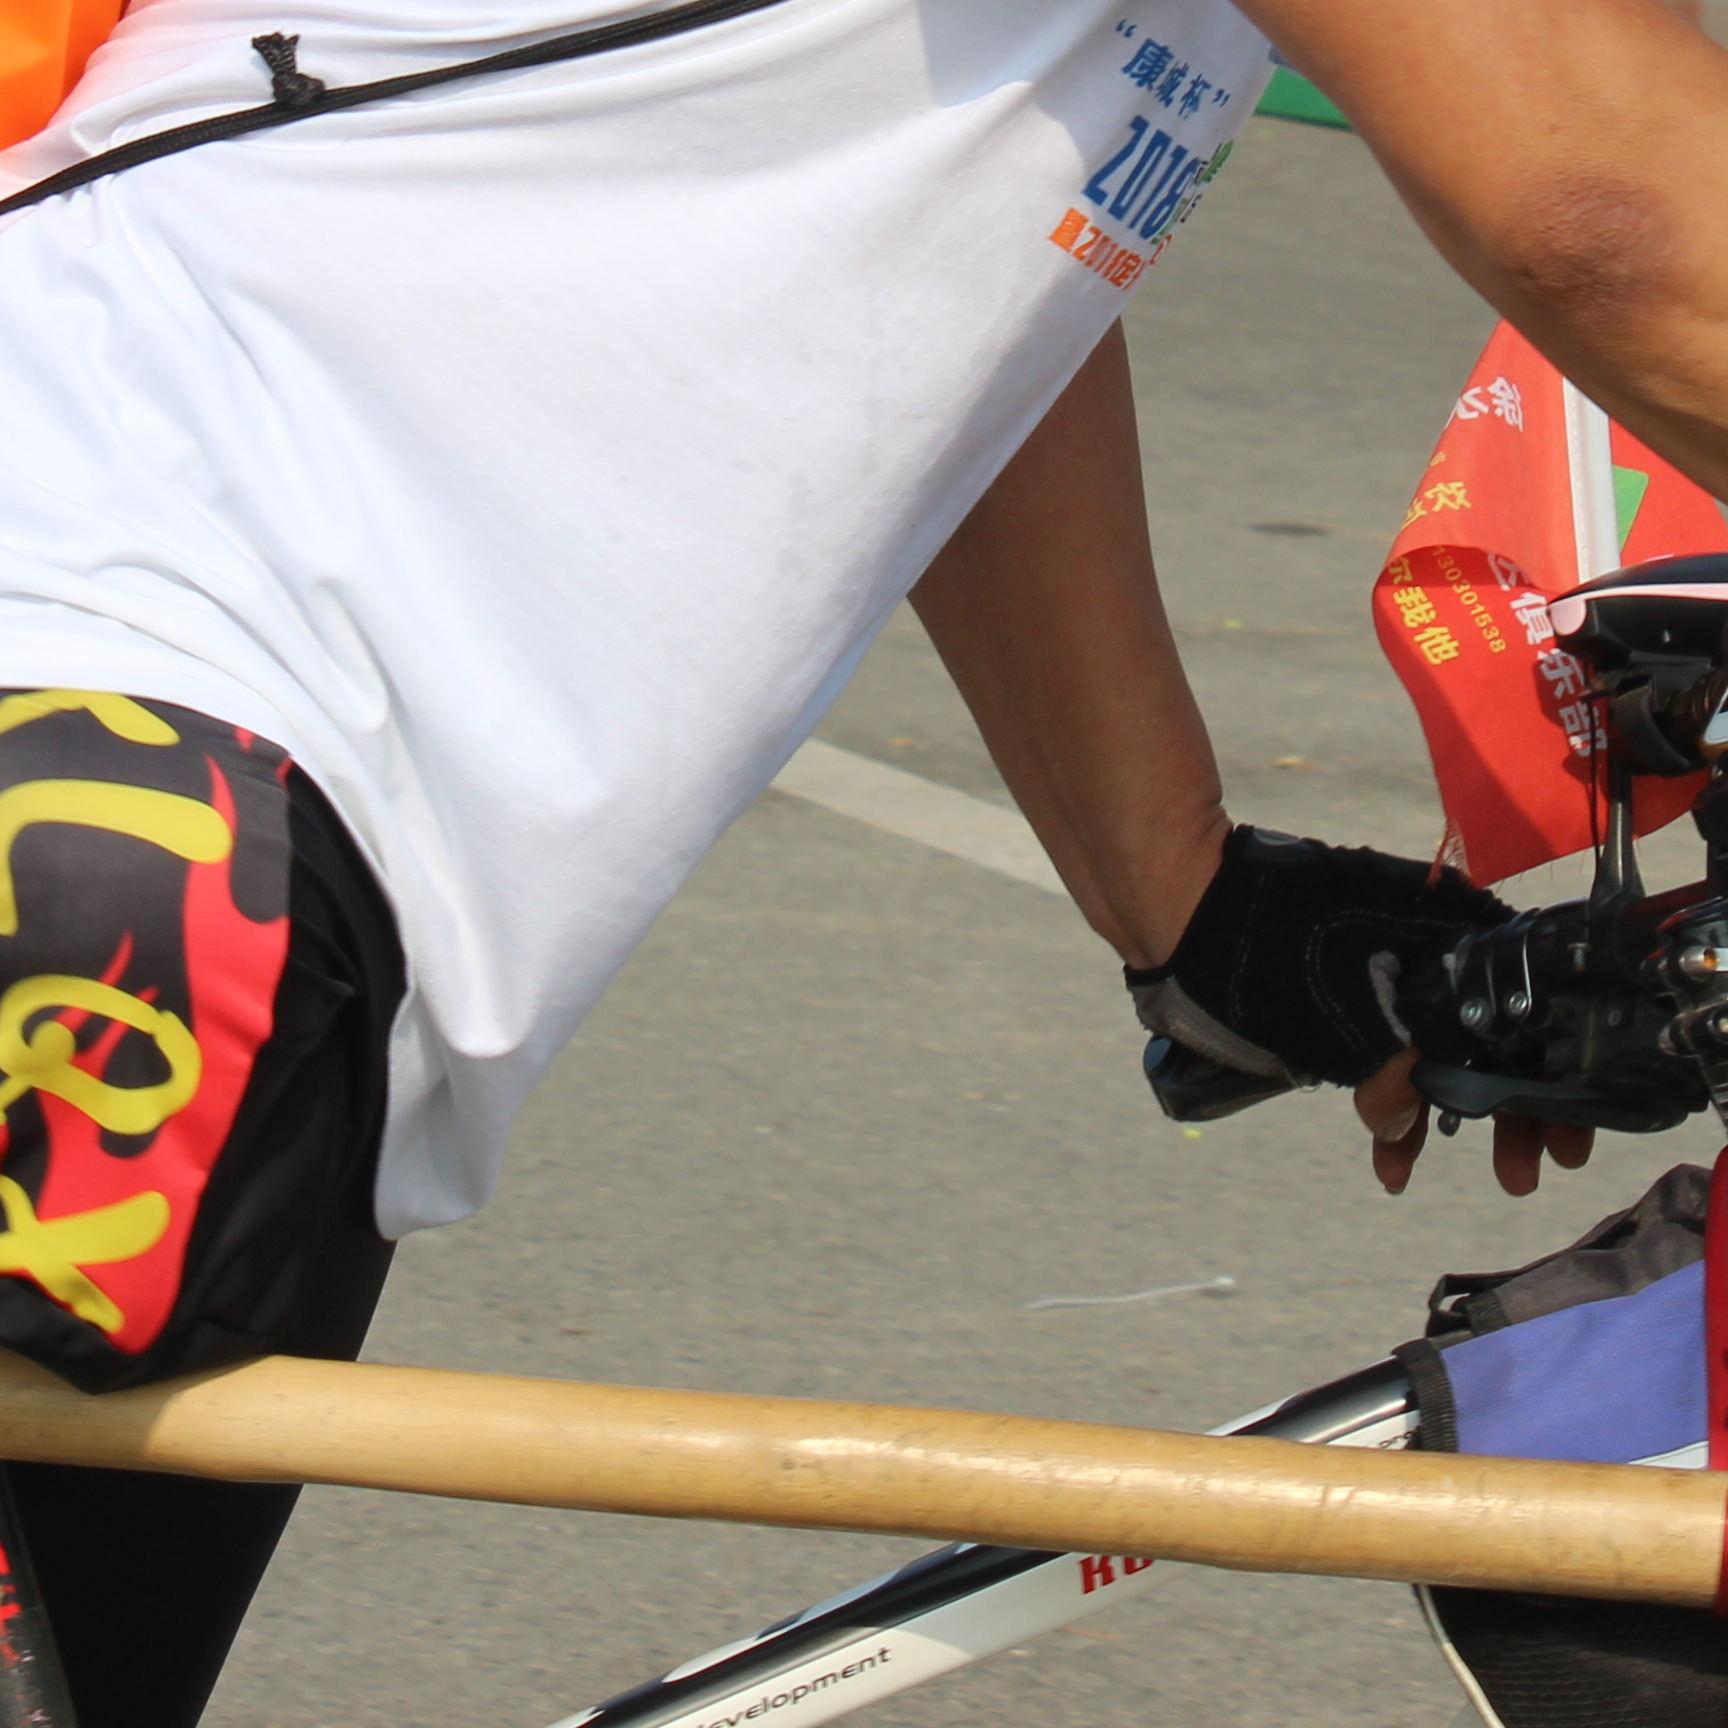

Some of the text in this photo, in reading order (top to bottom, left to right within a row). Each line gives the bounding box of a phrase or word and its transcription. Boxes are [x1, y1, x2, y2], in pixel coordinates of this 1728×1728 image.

[1115, 19, 1231, 119] “康城杯”
[1081, 115, 1204, 241] 2018
[699, 1646, 894, 1728] evelopment
